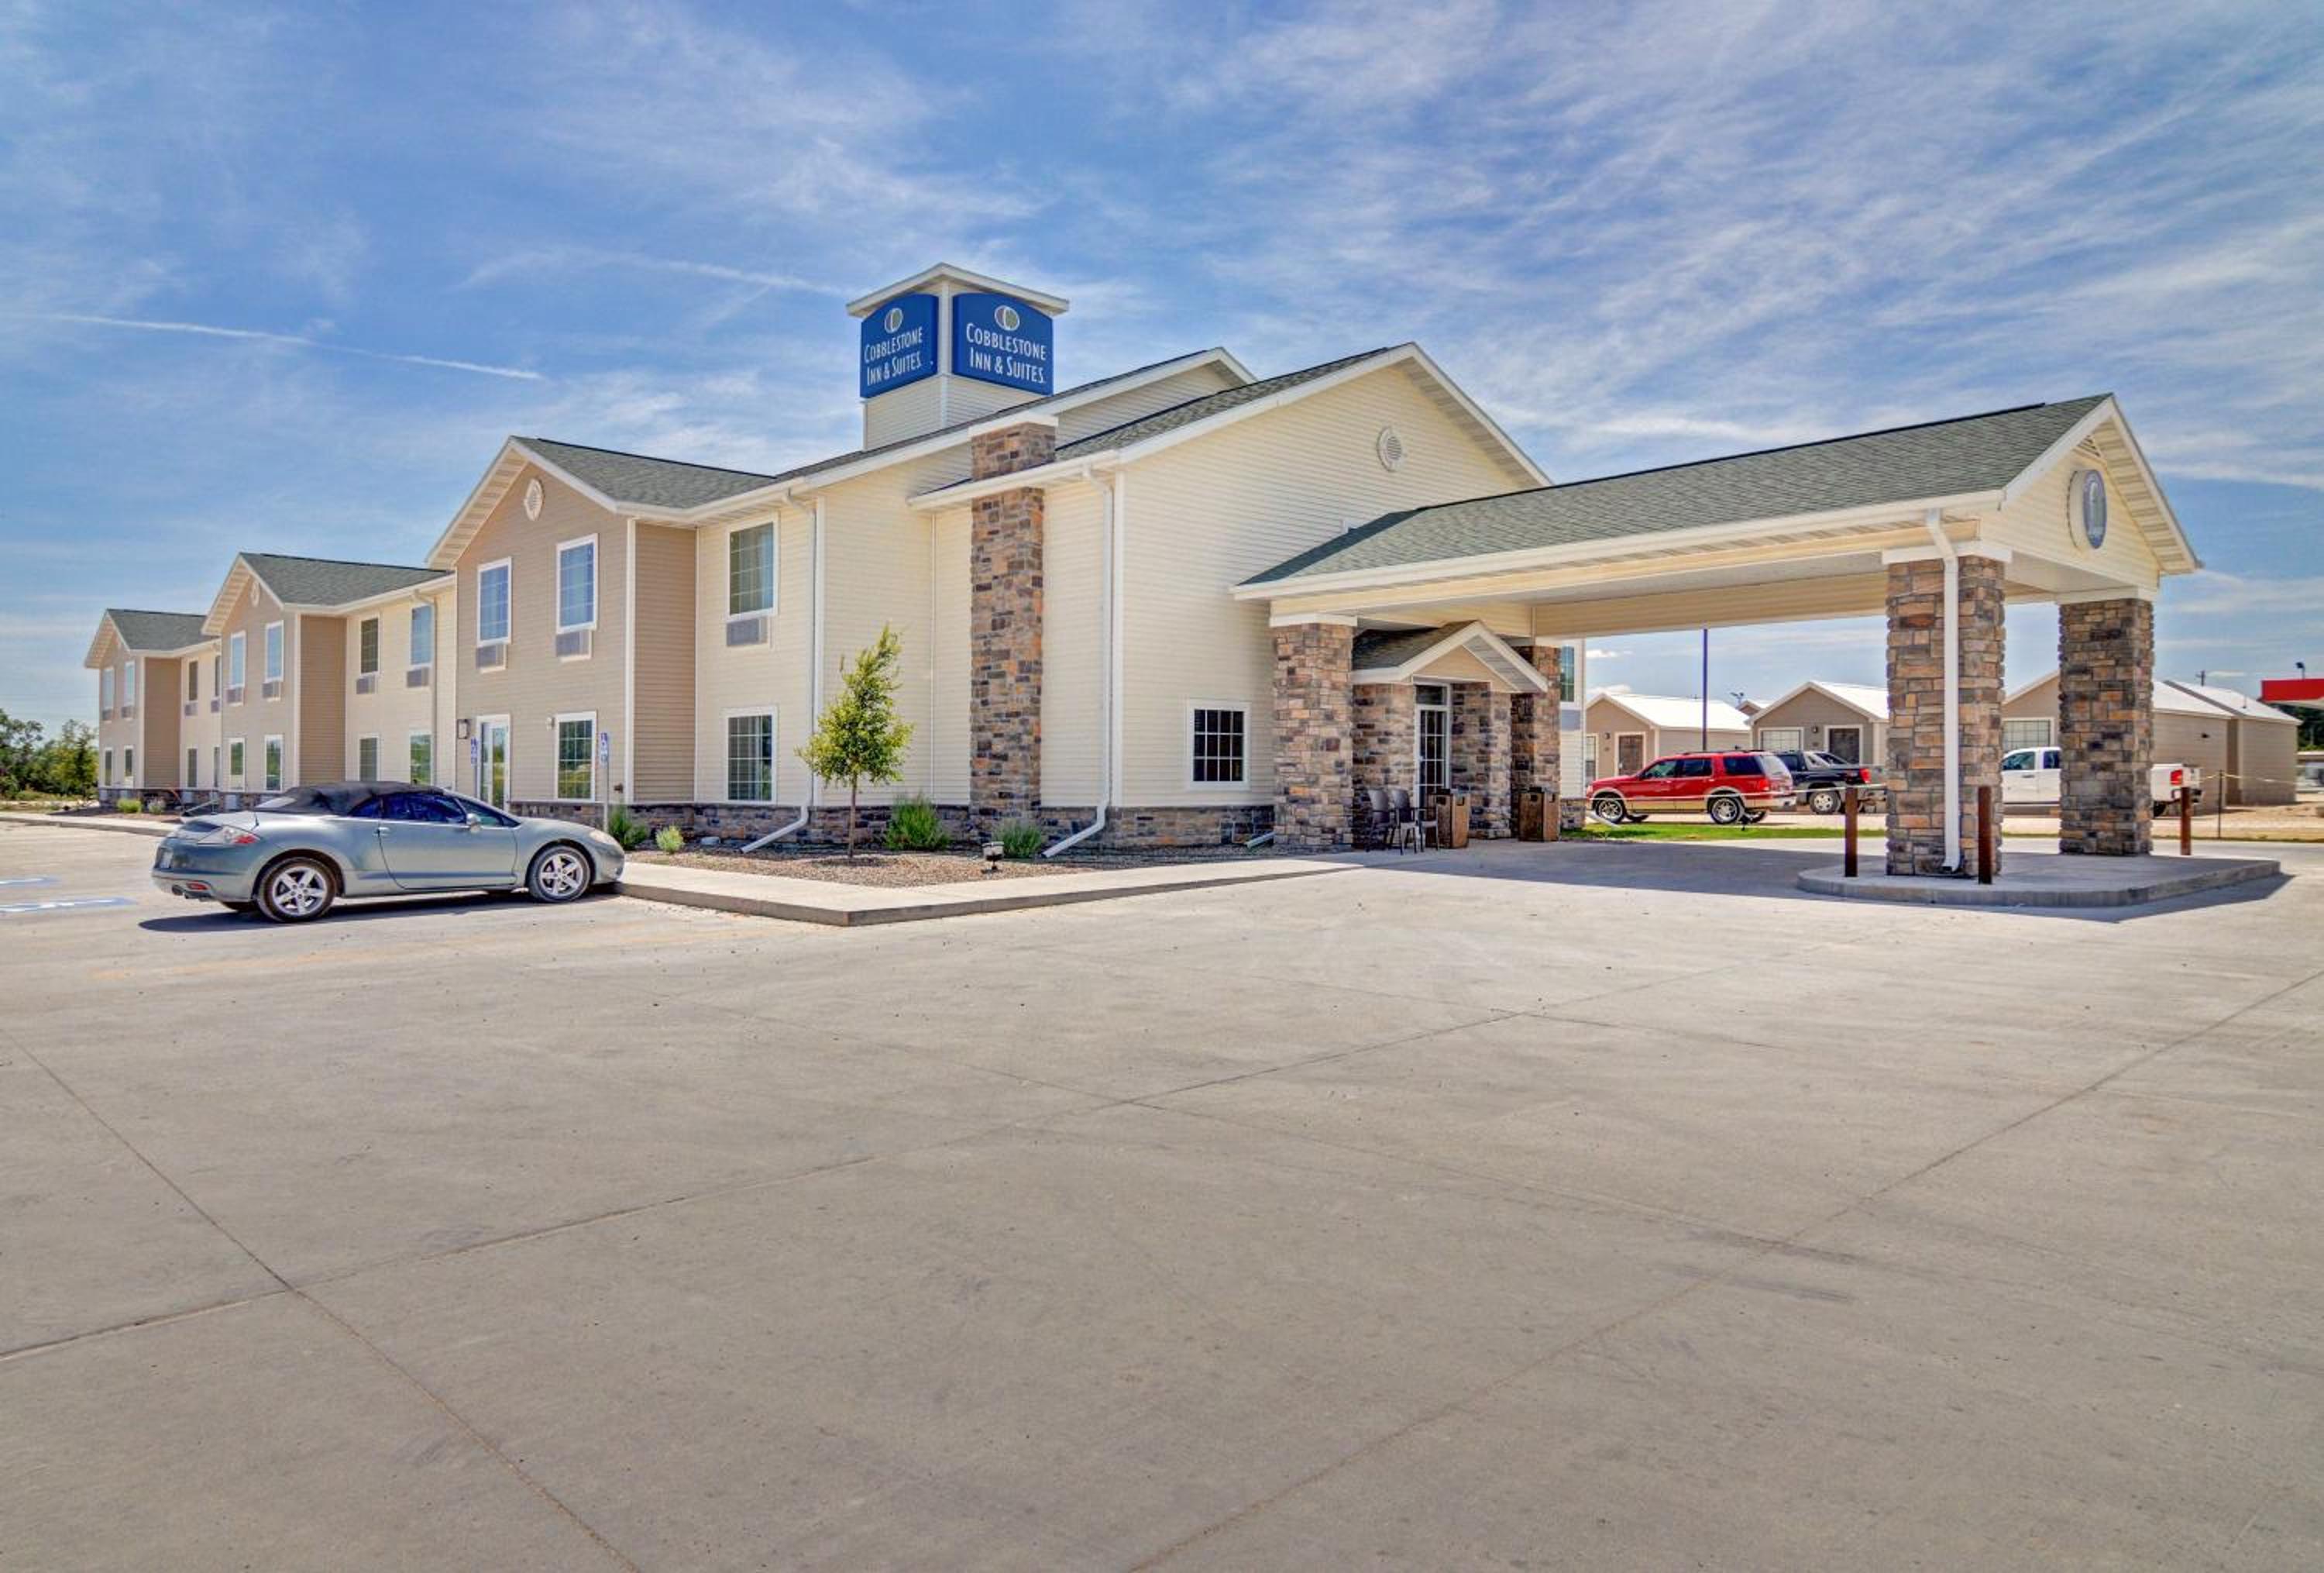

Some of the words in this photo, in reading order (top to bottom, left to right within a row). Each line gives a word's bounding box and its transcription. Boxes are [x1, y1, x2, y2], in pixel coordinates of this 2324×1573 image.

[864, 325, 923, 363] COBBLESTONE
[965, 322, 1047, 361] COBBLESTONE
[867, 366, 882, 387] INN
[884, 362, 891, 380] &
[892, 351, 922, 377] SUITES
[970, 346, 992, 373] INN
[995, 356, 1004, 375] &
[1006, 356, 1044, 384] SUITES
